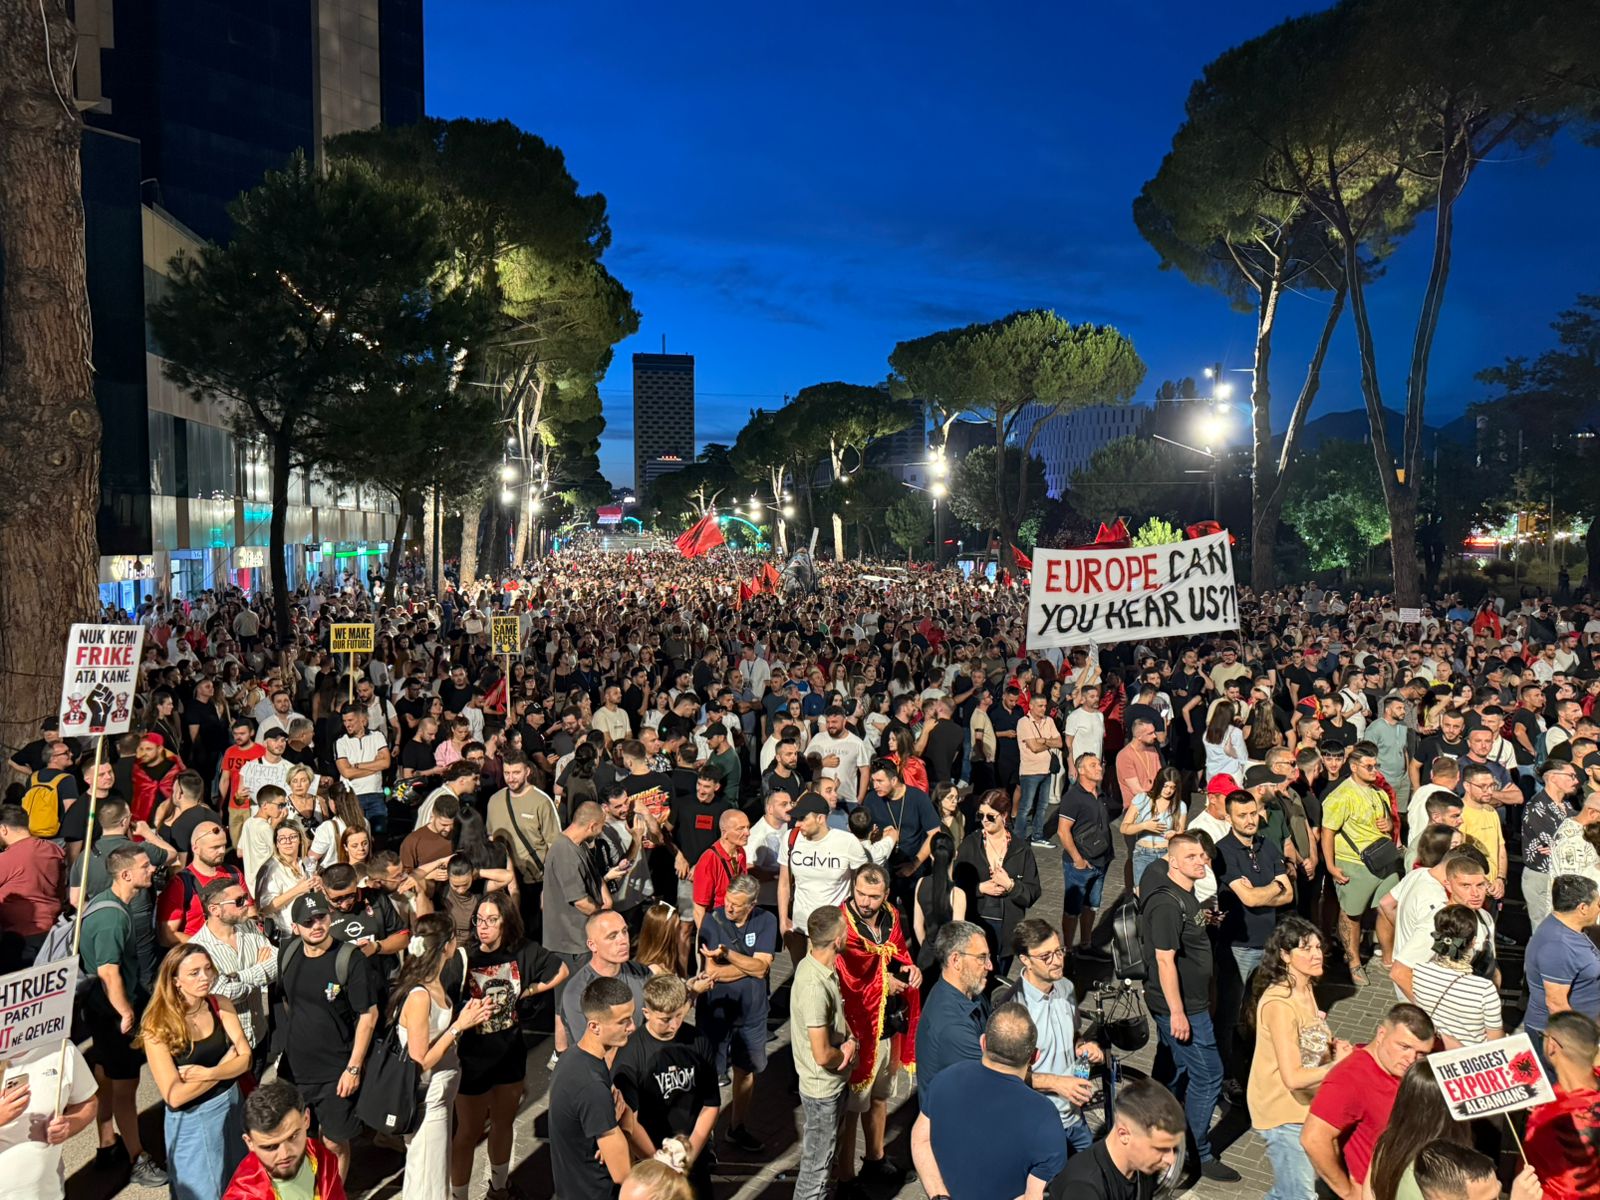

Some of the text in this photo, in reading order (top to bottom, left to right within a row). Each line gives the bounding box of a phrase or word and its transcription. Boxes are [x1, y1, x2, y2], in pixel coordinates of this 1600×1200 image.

[1169, 540, 1228, 583] CAN
[1038, 585, 1237, 636] YOU HEAR US?!
[78, 629, 137, 645] NUK KEMI
[334, 627, 371, 640] WE MAKE
[493, 624, 517, 636] SAME
[76, 643, 134, 666] FRIKË.
[332, 639, 372, 649] OUR FUTURE!
[75, 670, 97, 684] ATA
[791, 850, 841, 869] Calvin
[305, 896, 316, 908] LA
[4, 1001, 43, 1026] PARTI
[25, 1015, 65, 1041] QEVERI
[1436, 1049, 1509, 1080] THE BIGGEST
[652, 1065, 696, 1099] VENOM
[1443, 1066, 1516, 1103] EXPORT:
[1464, 1085, 1530, 1115] ALBANIANS
